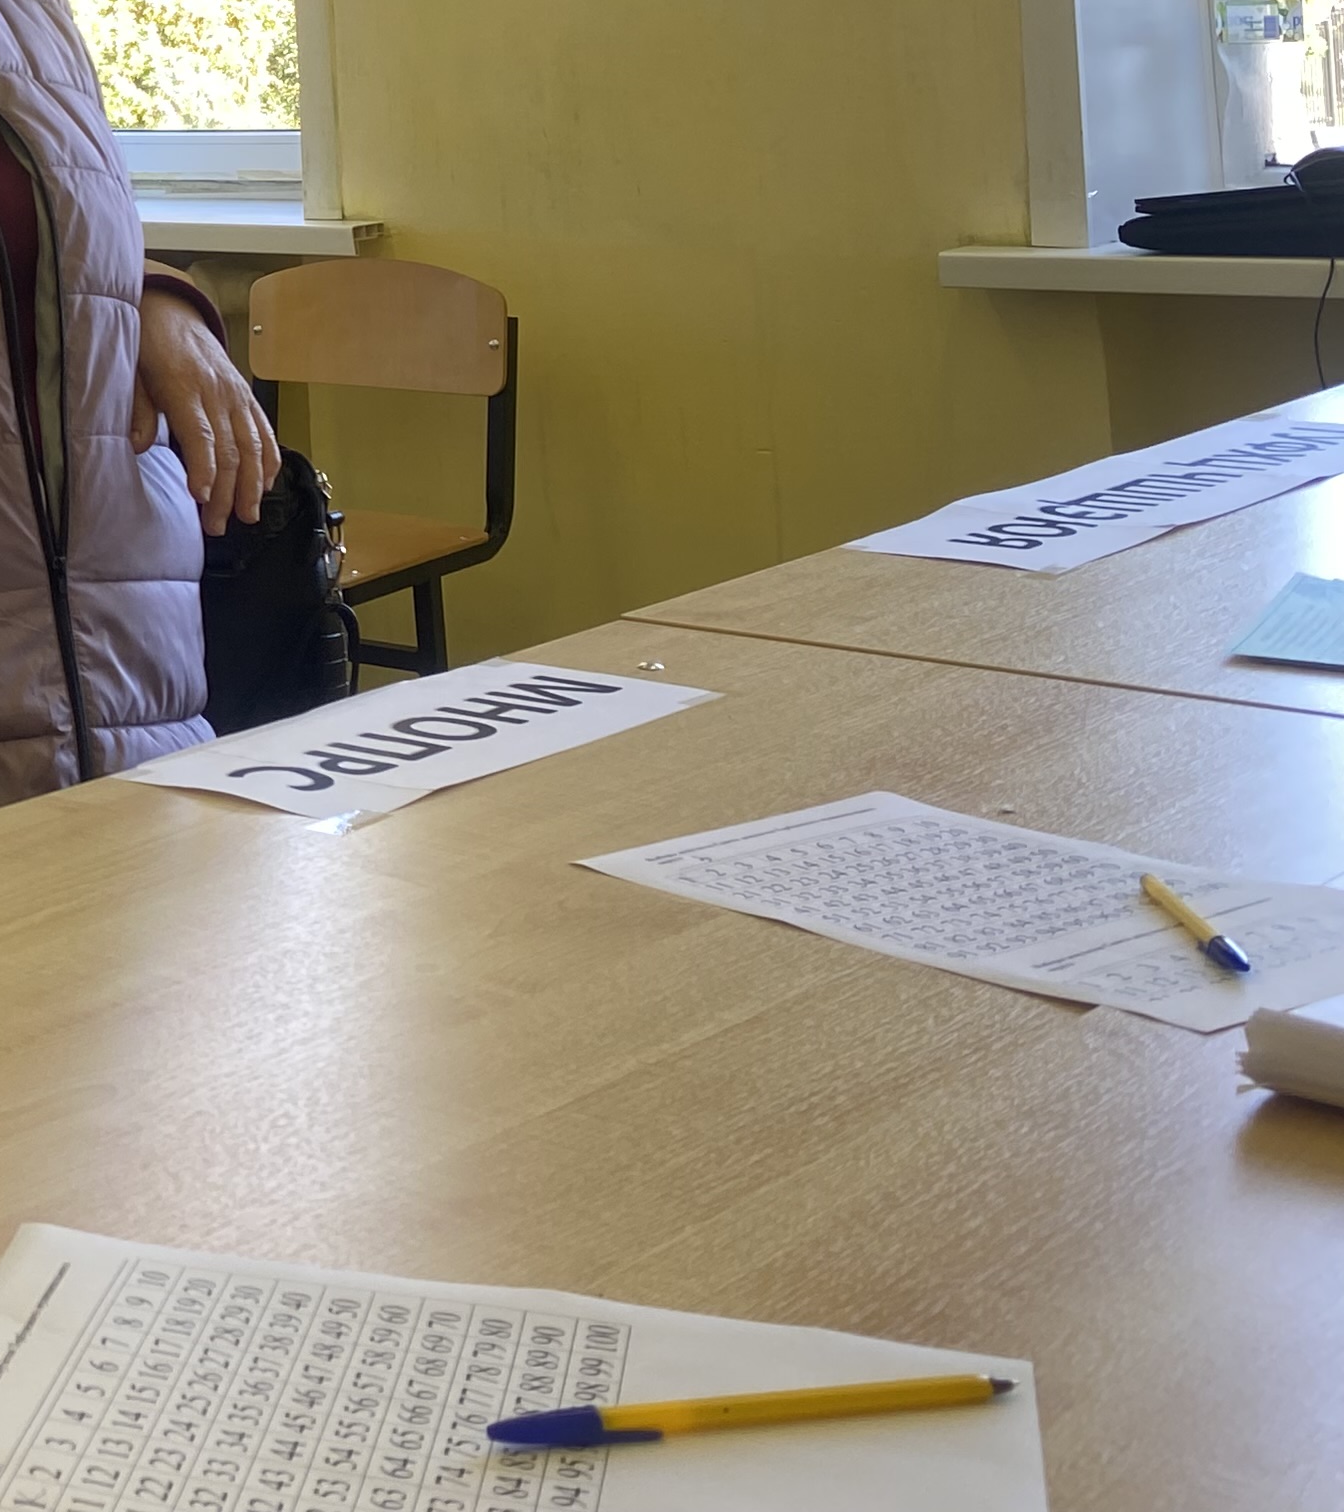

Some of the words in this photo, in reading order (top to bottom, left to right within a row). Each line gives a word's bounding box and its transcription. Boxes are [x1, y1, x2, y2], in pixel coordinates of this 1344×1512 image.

[228, 675, 624, 792] МНОПРС
[137, 1270, 170, 1288] 10
[182, 1278, 216, 1298] 20
[125, 1296, 153, 1307] 9
[229, 1285, 264, 1305] 30
[280, 1292, 312, 1311] 40
[172, 1297, 206, 1316] 19
[220, 1305, 253, 1326] 29
[327, 1298, 361, 1319] 50
[377, 1305, 411, 1325] 60
[113, 1316, 143, 1329] 8
[161, 1318, 196, 1337] 18
[268, 1313, 302, 1333] 39
[320, 1320, 352, 1340] 49
[426, 1311, 462, 1330] 70
[478, 1318, 513, 1339] 80
[100, 1336, 129, 1347] 7
[209, 1326, 244, 1347] 28
[258, 1334, 294, 1355] 38
[369, 1327, 402, 1347] 59
[421, 1334, 454, 1354] 69
[530, 1326, 565, 1346] 90
[584, 1324, 620, 1352] 100
[150, 1337, 183, 1358] 17
[198, 1347, 231, 1369] 27
[310, 1342, 344, 1362] 48
[472, 1342, 506, 1360] 79
[89, 1360, 119, 1373] 6
[248, 1356, 282, 1377] 37
[360, 1349, 396, 1370] 58
[413, 1356, 448, 1377] 68
[525, 1349, 560, 1370] 89
[579, 1357, 614, 1378] 99
[137, 1360, 173, 1381] 16
[302, 1364, 332, 1384] 47
[465, 1364, 502, 1384] 78
[76, 1383, 106, 1398] 5
[187, 1370, 223, 1393] 26
[238, 1377, 276, 1401] 36
[352, 1371, 384, 1393] 57
[406, 1378, 439, 1400] 67
[519, 1373, 555, 1394] 88
[574, 1381, 610, 1403] 98
[125, 1383, 161, 1404] 15
[291, 1388, 326, 1408] 46
[458, 1387, 491, 1405] 77
[175, 1393, 212, 1417] 25
[227, 1402, 263, 1426] 35
[343, 1395, 380, 1418] 56
[397, 1403, 433, 1425] 66
[62, 1409, 92, 1423] 4
[112, 1409, 148, 1430] 14
[282, 1412, 316, 1433] 45
[450, 1412, 488, 1436] 76
[163, 1419, 199, 1443] 24
[215, 1429, 252, 1453] 34
[334, 1419, 370, 1443] 55
[389, 1427, 425, 1450] 65
[44, 1437, 77, 1452] 3
[97, 1437, 134, 1459] 13
[270, 1439, 305, 1461] 44
[444, 1437, 480, 1456] 75
[148, 1447, 186, 1472] 23
[324, 1447, 361, 1471] 54
[380, 1456, 416, 1479] 64
[557, 1457, 595, 1480] 95
[29, 1465, 62, 1481] 2
[82, 1465, 121, 1489] 12
[202, 1458, 240, 1482] 33
[258, 1468, 295, 1491] 43
[435, 1466, 473, 1485] 74
[134, 1477, 174, 1502] 22
[313, 1478, 351, 1502] 53
[493, 1476, 530, 1499] 84
[551, 1486, 590, 1509] 94
[370, 1487, 407, 1511] 63
